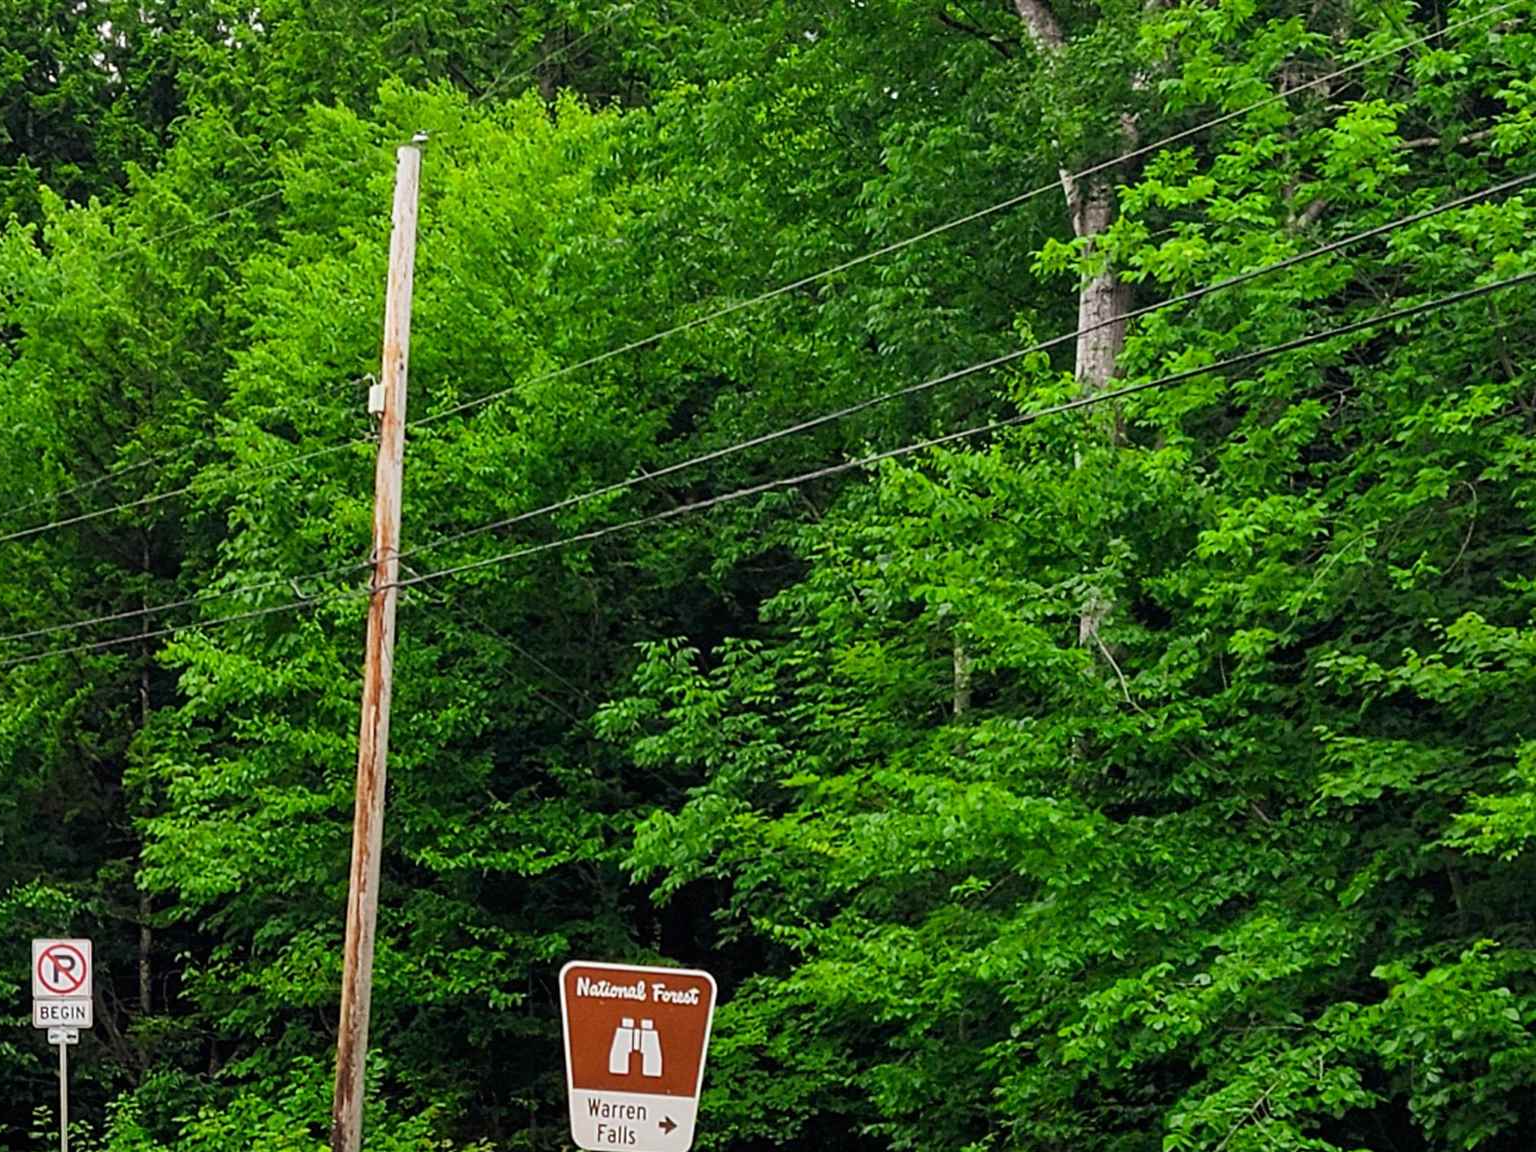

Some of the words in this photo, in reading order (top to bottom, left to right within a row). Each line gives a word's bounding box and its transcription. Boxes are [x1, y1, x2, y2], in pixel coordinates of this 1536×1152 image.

[576, 976, 646, 1001] National
[652, 983, 700, 1005] Forest
[40, 1006, 86, 1020] BEGIN
[588, 1097, 647, 1121] Warren
[597, 1123, 636, 1145] Falls
